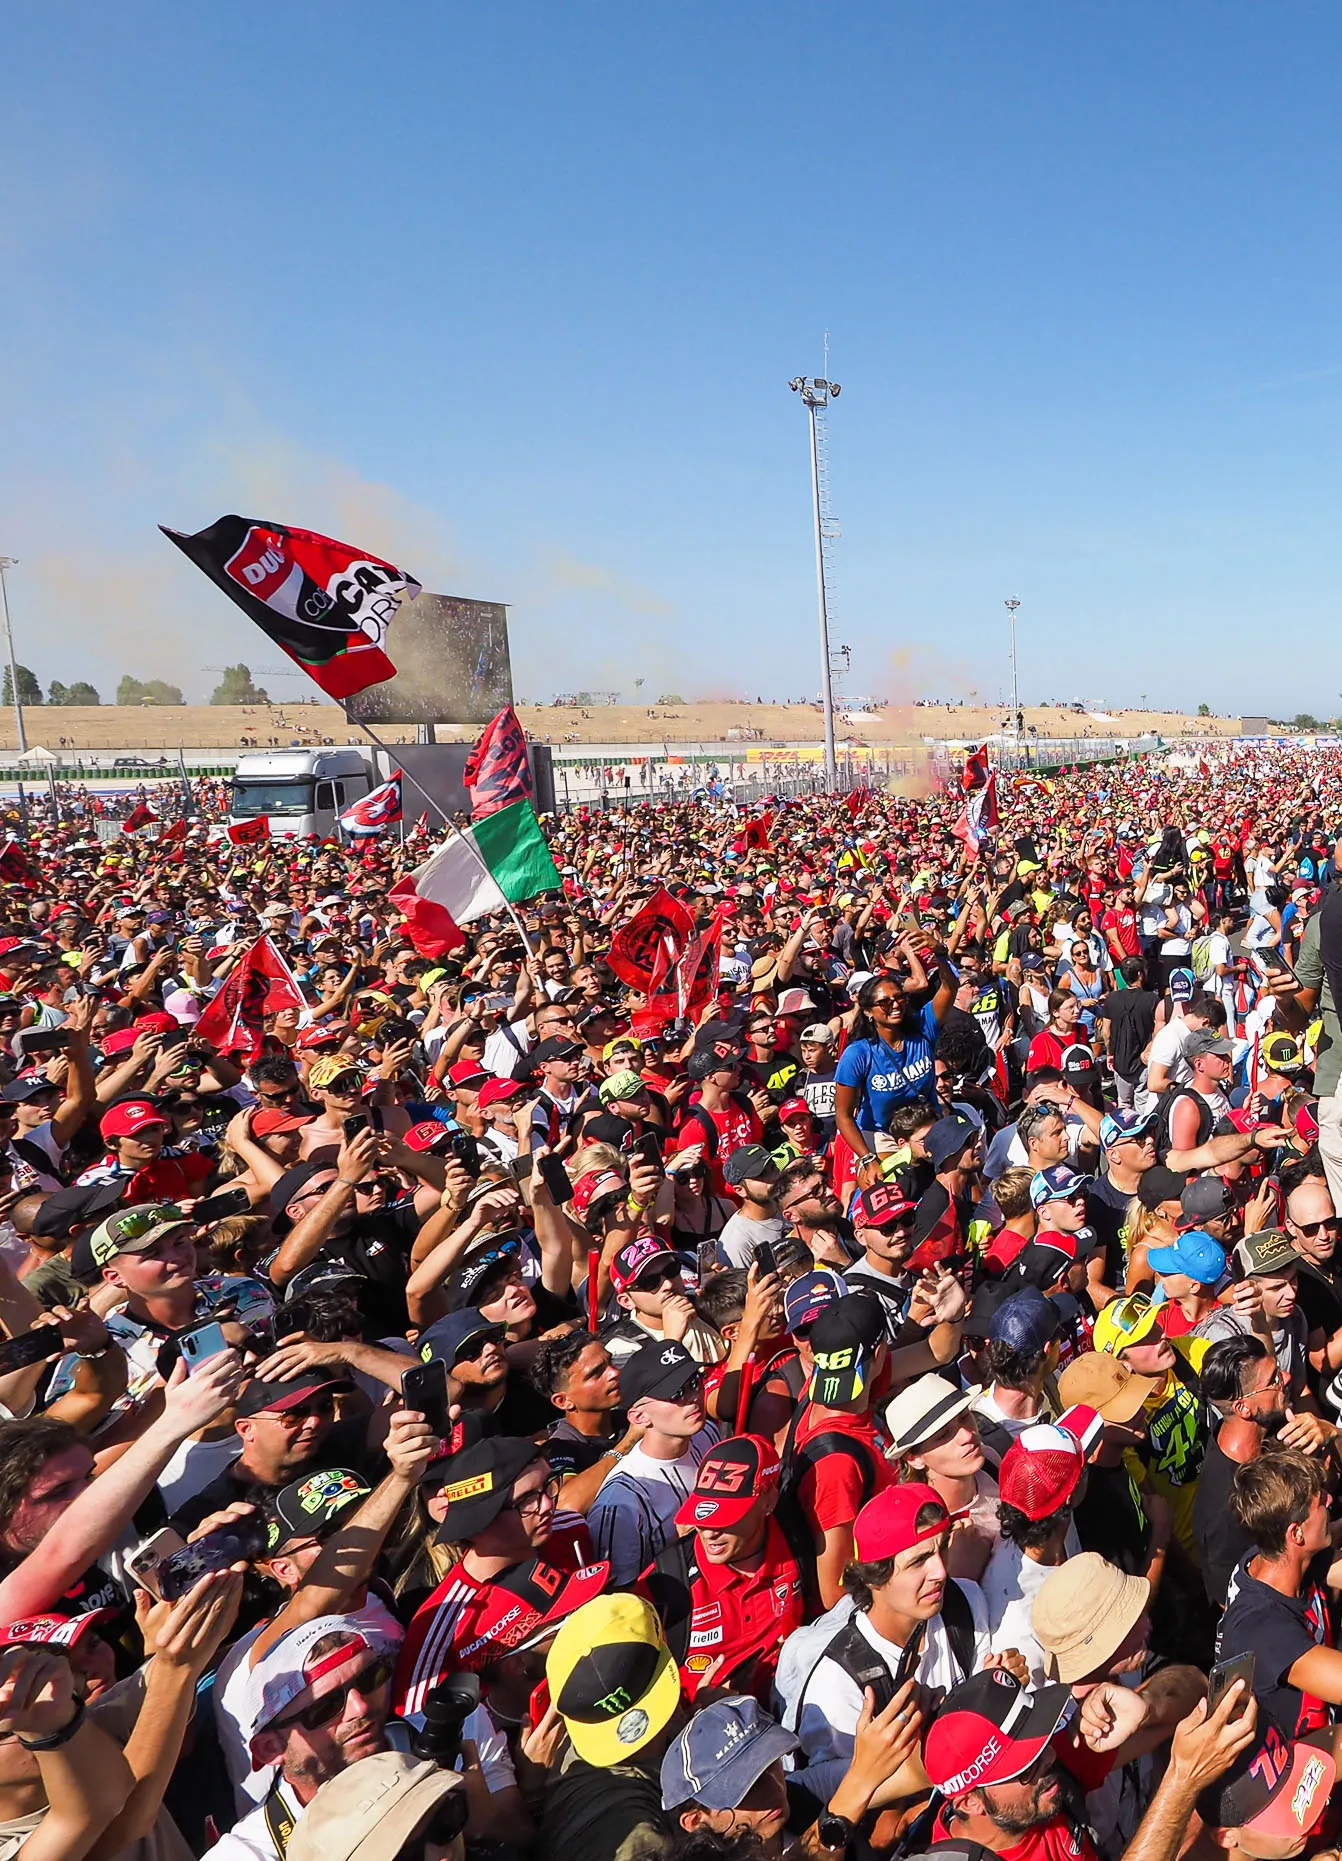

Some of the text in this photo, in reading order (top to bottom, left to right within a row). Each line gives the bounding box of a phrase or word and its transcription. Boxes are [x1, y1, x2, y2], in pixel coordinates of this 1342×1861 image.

[16, 1165, 33, 1178] 58
[870, 1183, 904, 1212] 63
[620, 1236, 661, 1269] 23
[813, 1348, 853, 1371] 46
[697, 1459, 750, 1493] 63
[459, 1605, 523, 1659] DUCATI CORSE
[693, 1630, 719, 1643] riello
[715, 1721, 759, 1760] MASERATI
[961, 1735, 1002, 1785] CORSE
[1249, 1725, 1289, 1792] 72
